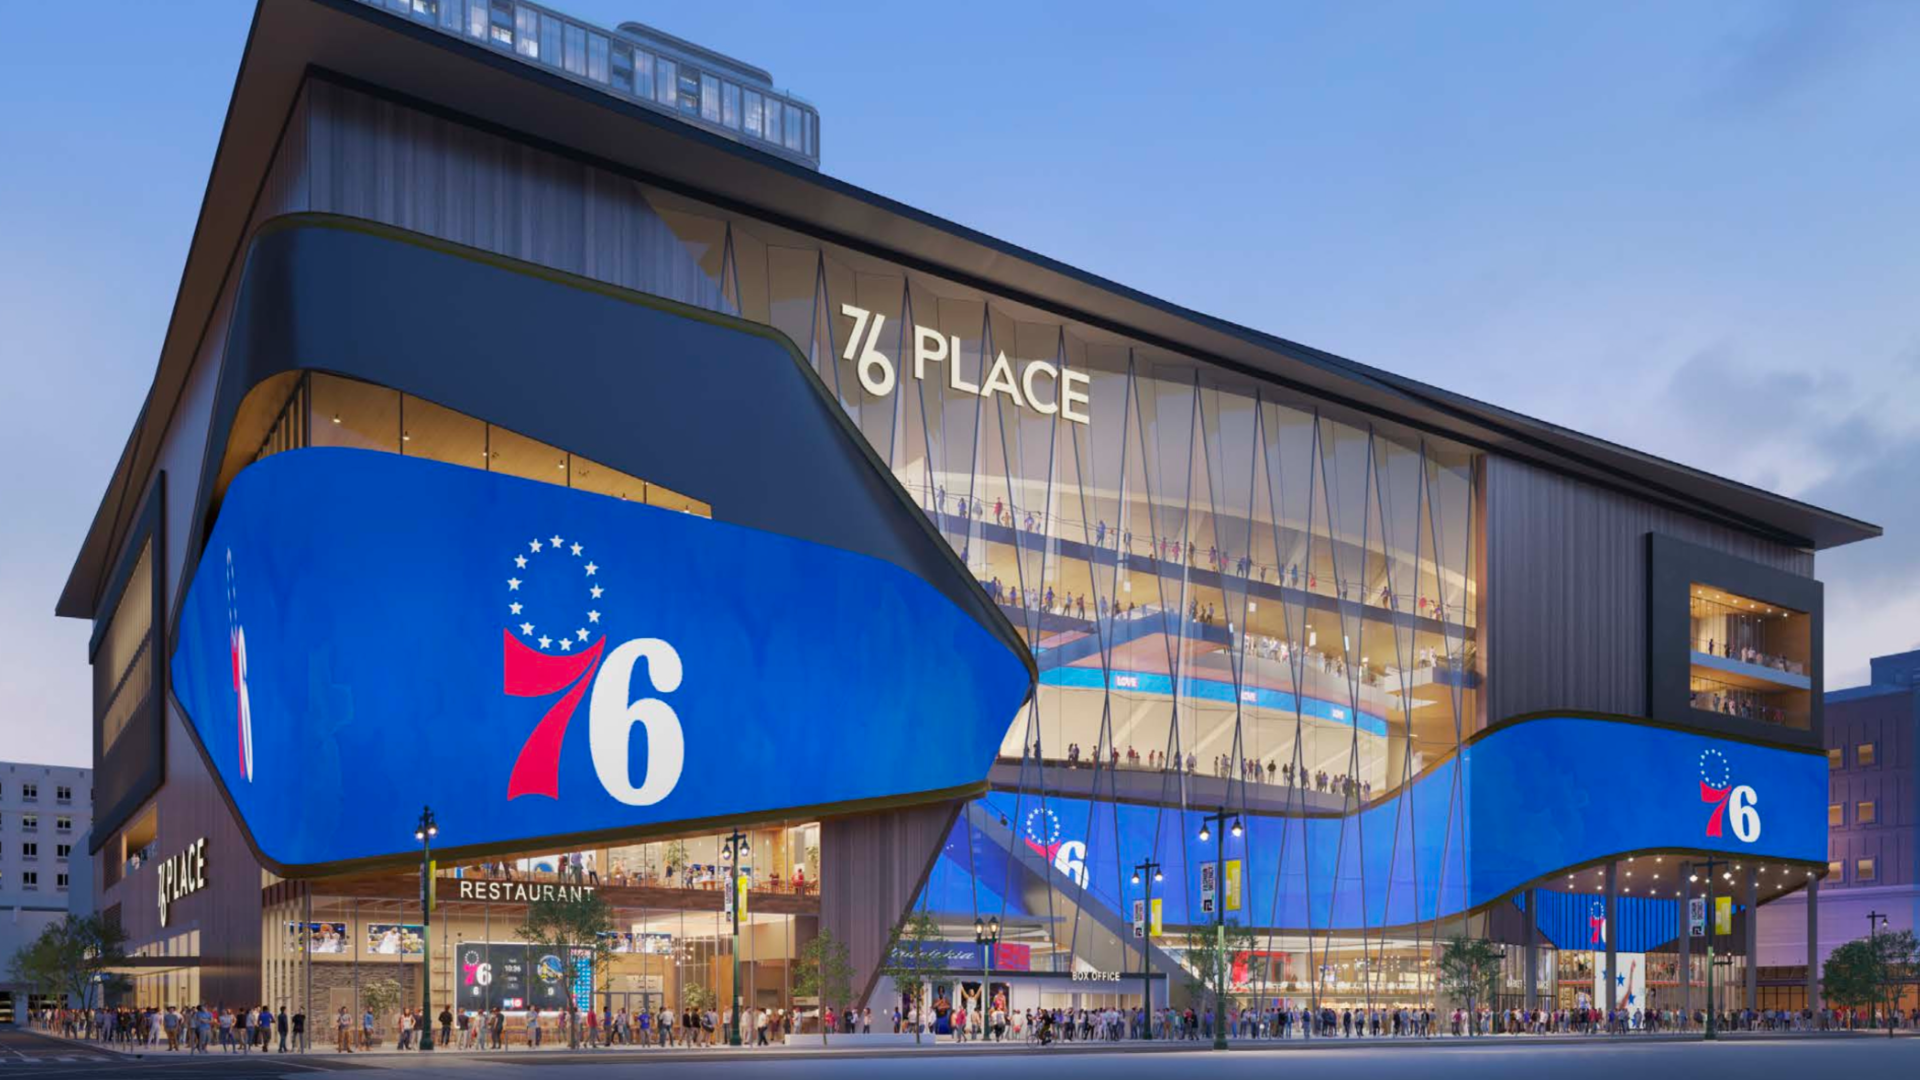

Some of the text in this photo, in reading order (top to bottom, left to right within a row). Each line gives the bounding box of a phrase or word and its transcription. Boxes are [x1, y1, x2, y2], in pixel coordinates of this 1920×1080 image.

[842, 303, 1090, 424] 76 PLACE
[1116, 676, 1138, 687] LOVE
[504, 627, 686, 806] 76
[1699, 780, 1761, 843] 76
[167, 838, 204, 903] PLACE
[460, 881, 595, 902] RESTAURANT
[463, 963, 492, 986] 76
[1072, 971, 1120, 982] BOX OFFICE
